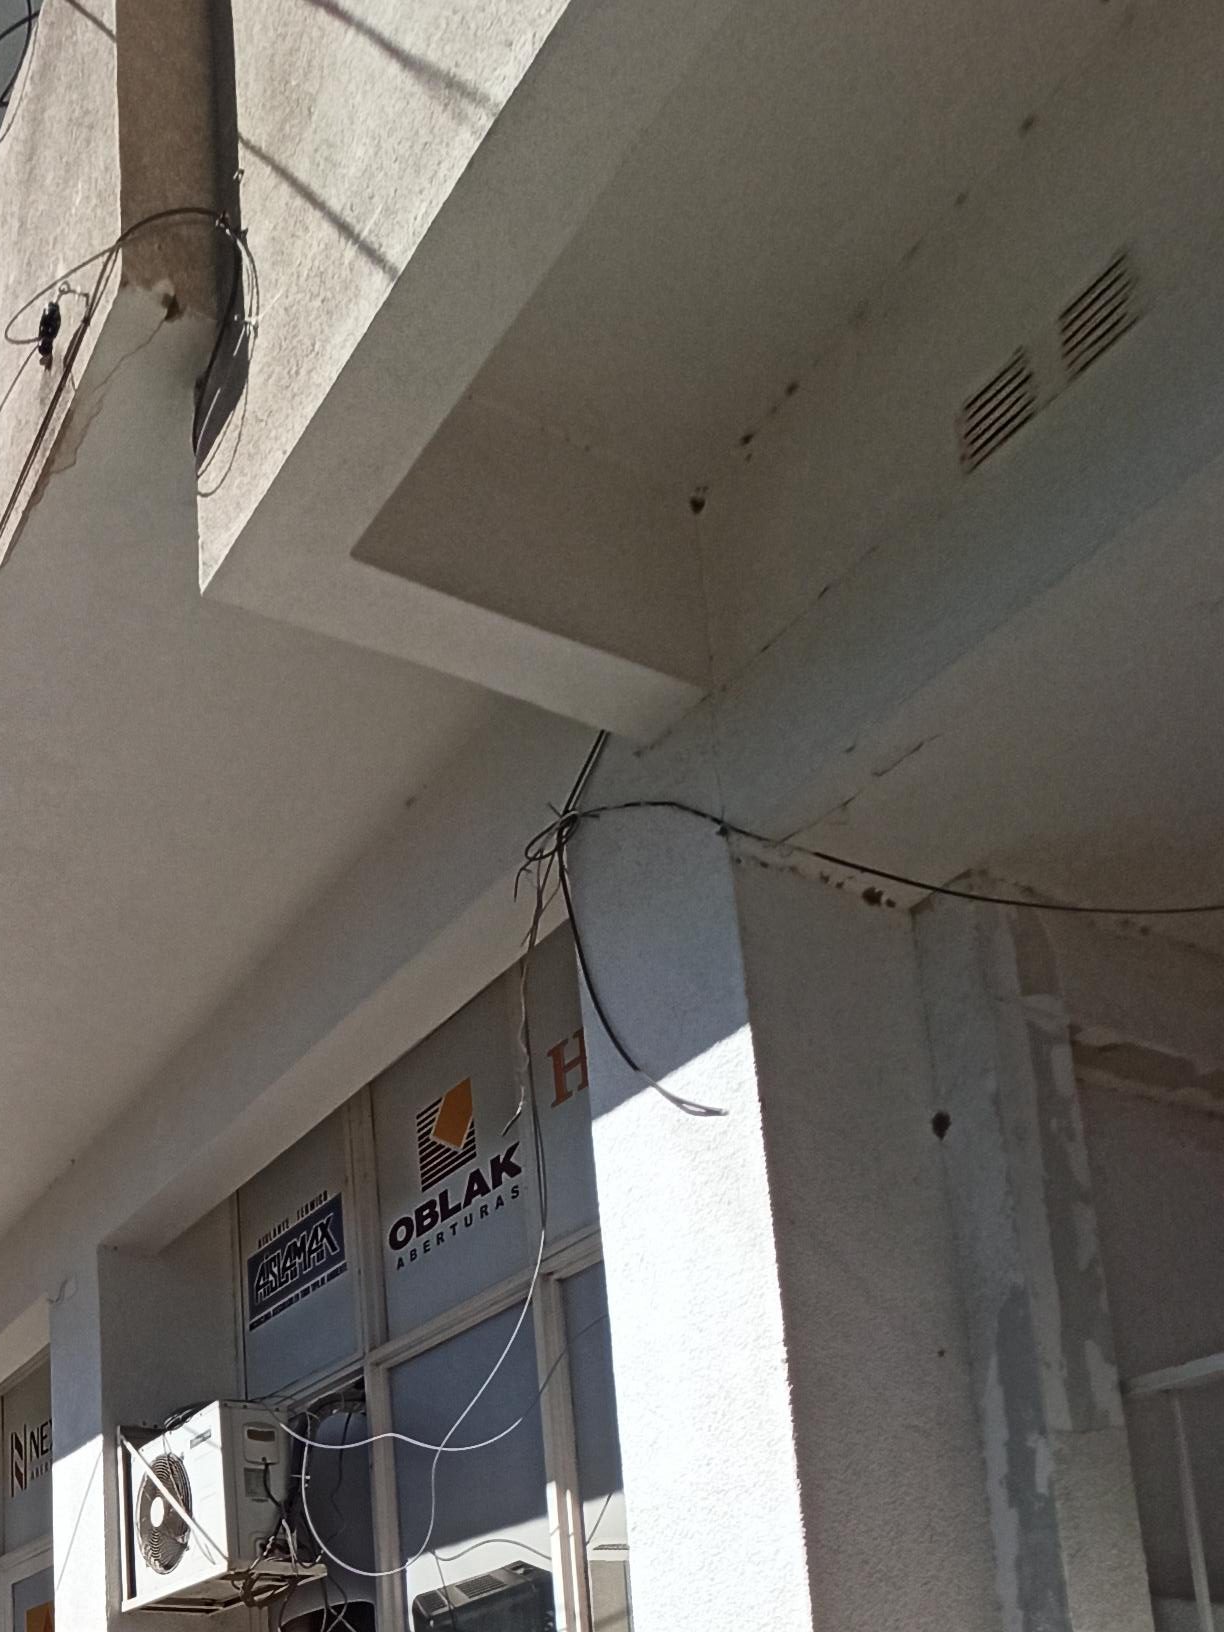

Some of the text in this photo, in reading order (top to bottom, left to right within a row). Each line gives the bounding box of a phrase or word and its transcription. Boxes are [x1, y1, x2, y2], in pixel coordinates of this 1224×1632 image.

[388, 1142, 523, 1252] OBLAK
[396, 1185, 521, 1271] ABERTURAS
[253, 1212, 341, 1307] AISLAMAX
